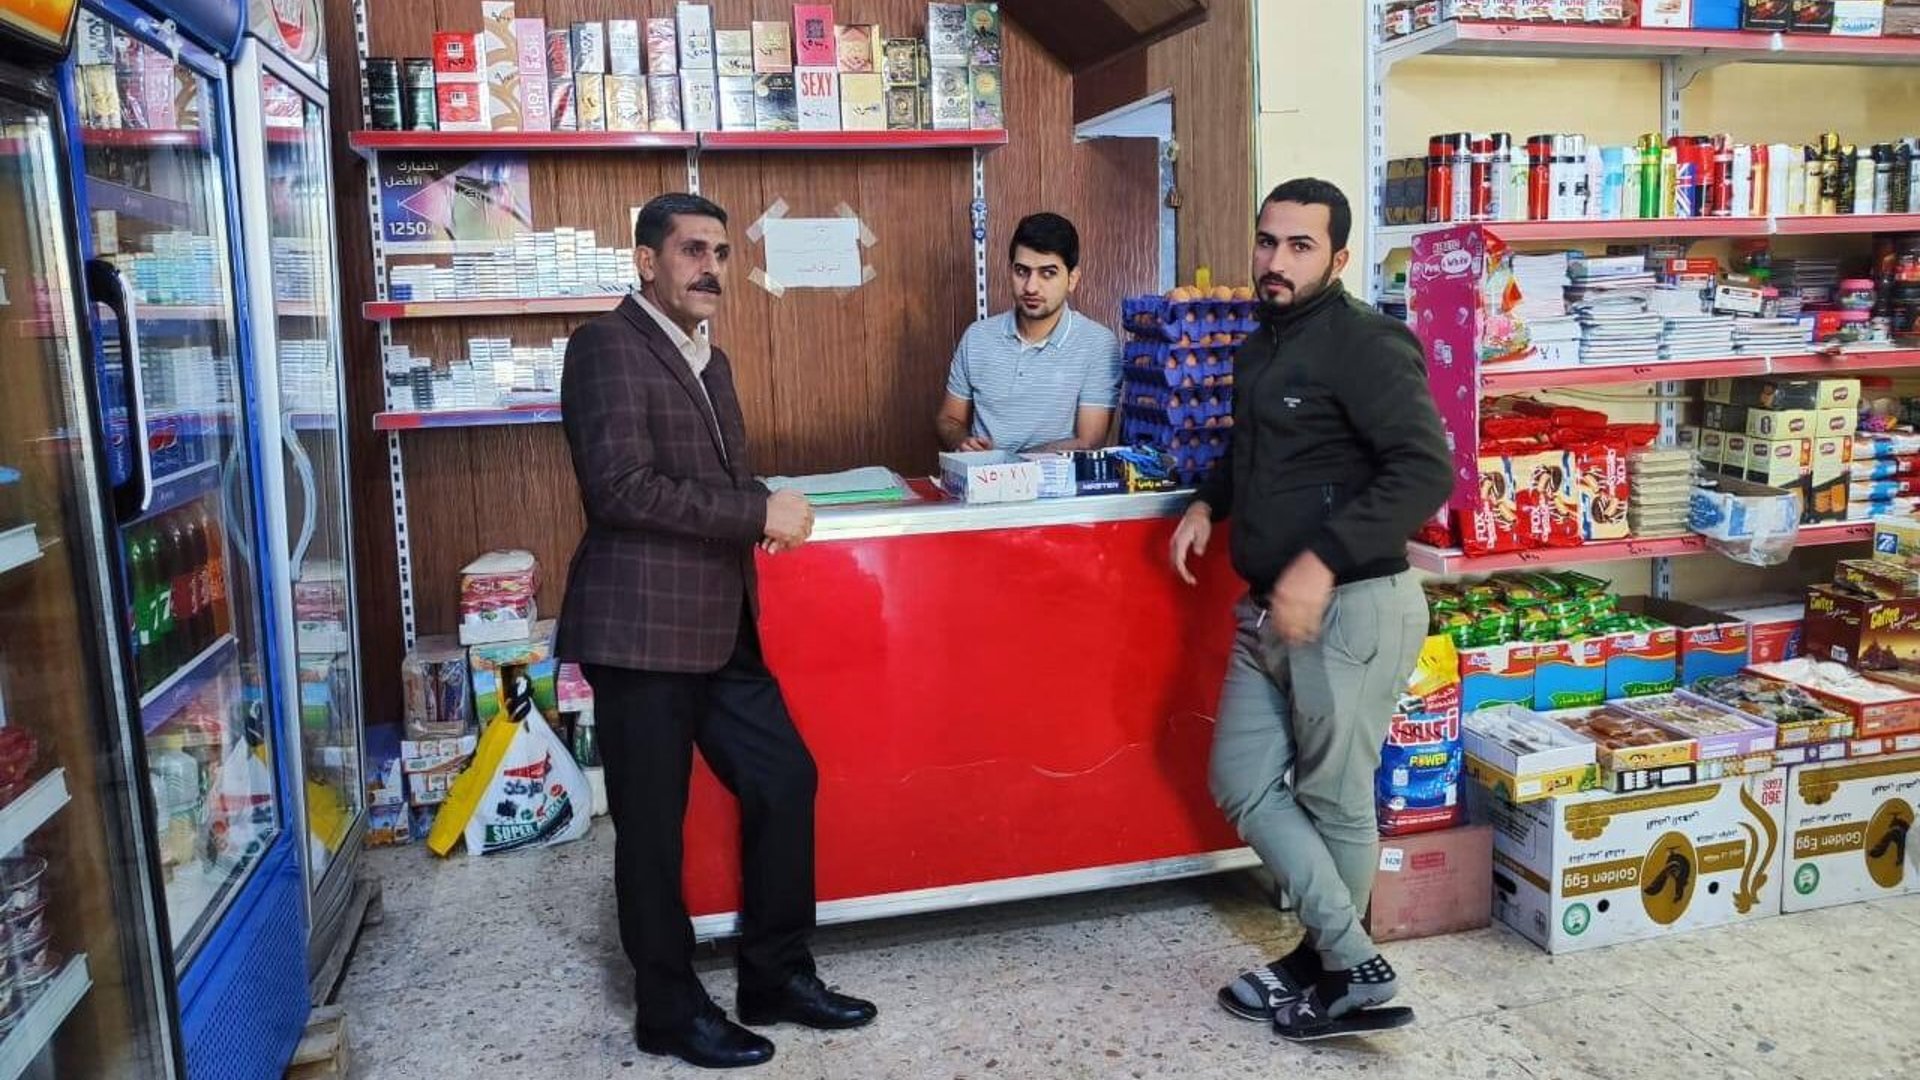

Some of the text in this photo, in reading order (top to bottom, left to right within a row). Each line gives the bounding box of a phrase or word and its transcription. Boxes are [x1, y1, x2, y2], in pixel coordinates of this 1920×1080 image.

[801, 71, 832, 97] SEXY
[389, 221, 427, 236] 1250
[1616, 457, 1626, 485] FOX
[1474, 510, 1488, 542] FOX
[1530, 507, 1543, 534] FOX
[1410, 752, 1448, 767] POWER
[1761, 791, 1782, 806] 360
[493, 823, 536, 841] SUPER
[1796, 831, 1861, 851] Golden Egg
[1564, 866, 1637, 889] Golden Egg
